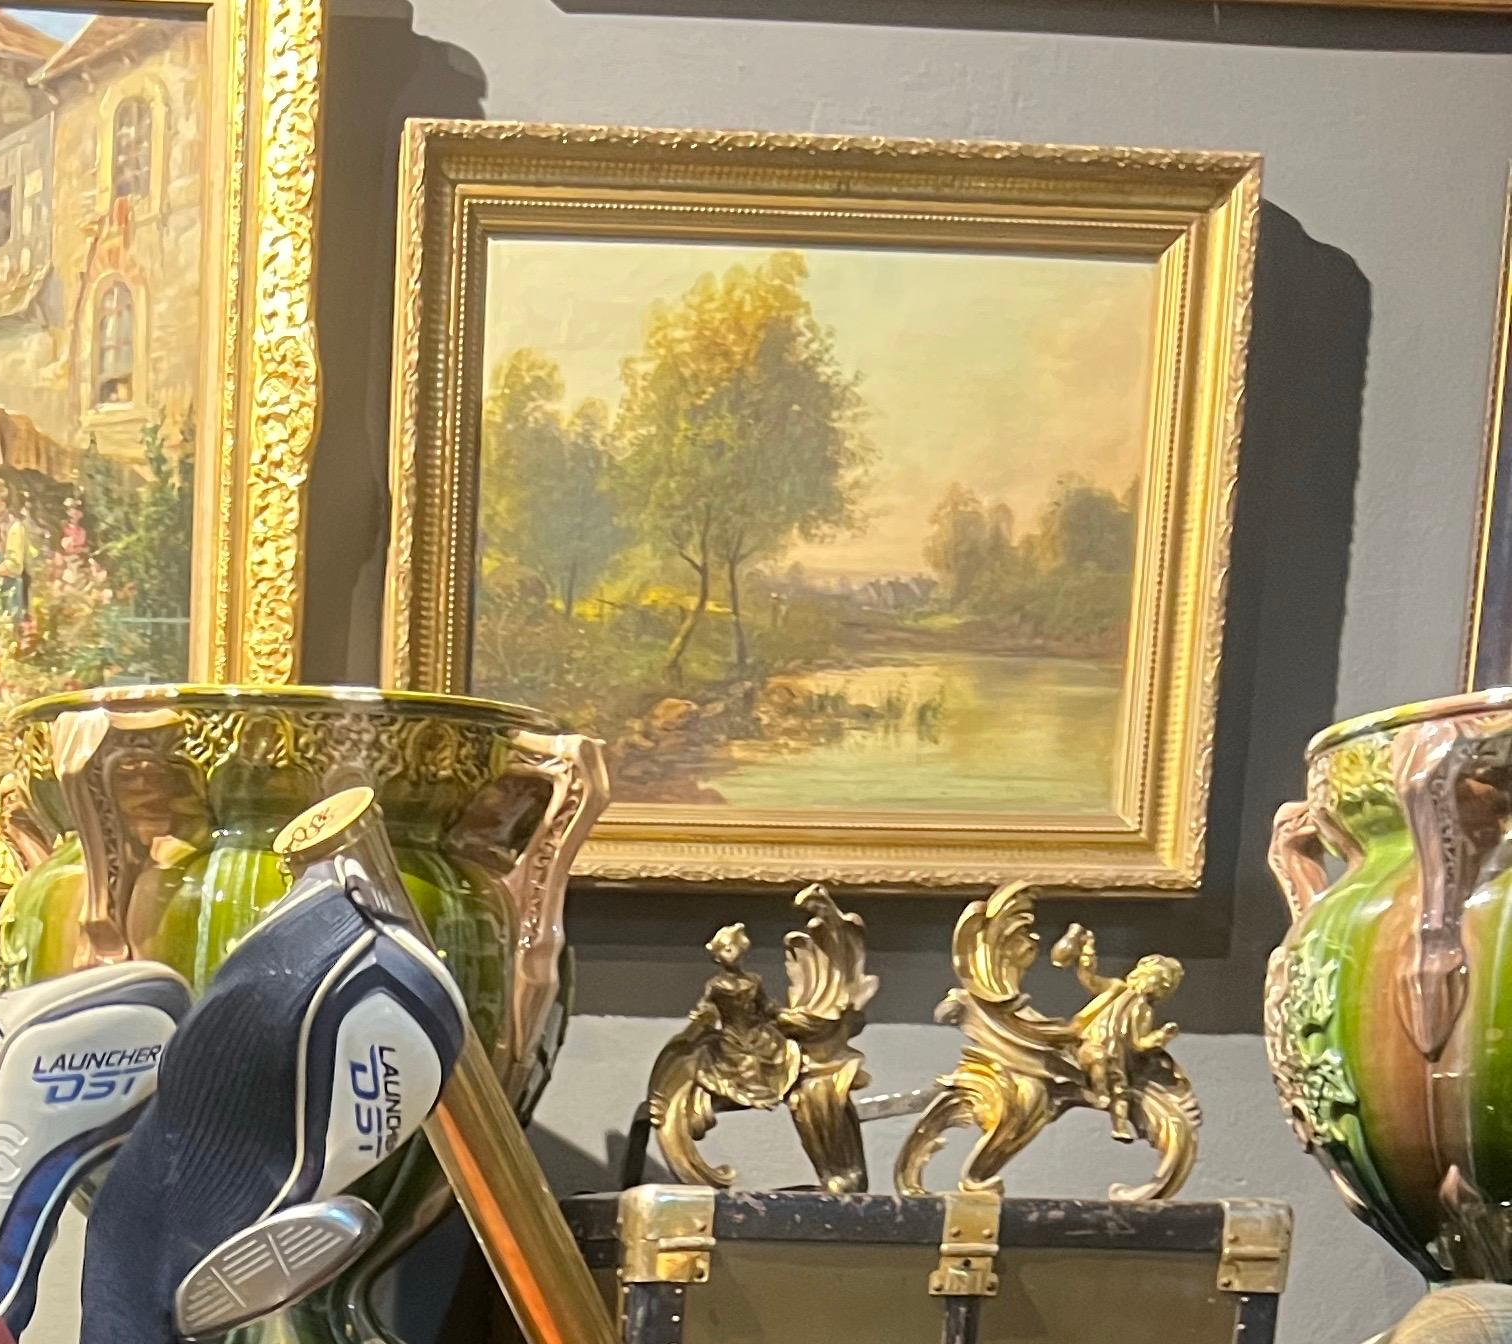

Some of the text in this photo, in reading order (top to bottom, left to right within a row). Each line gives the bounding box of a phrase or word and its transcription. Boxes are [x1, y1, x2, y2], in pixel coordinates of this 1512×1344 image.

[33, 1044, 162, 1074] LAUNCHER
[32, 1063, 157, 1104] DST
[349, 1043, 383, 1159] DST
